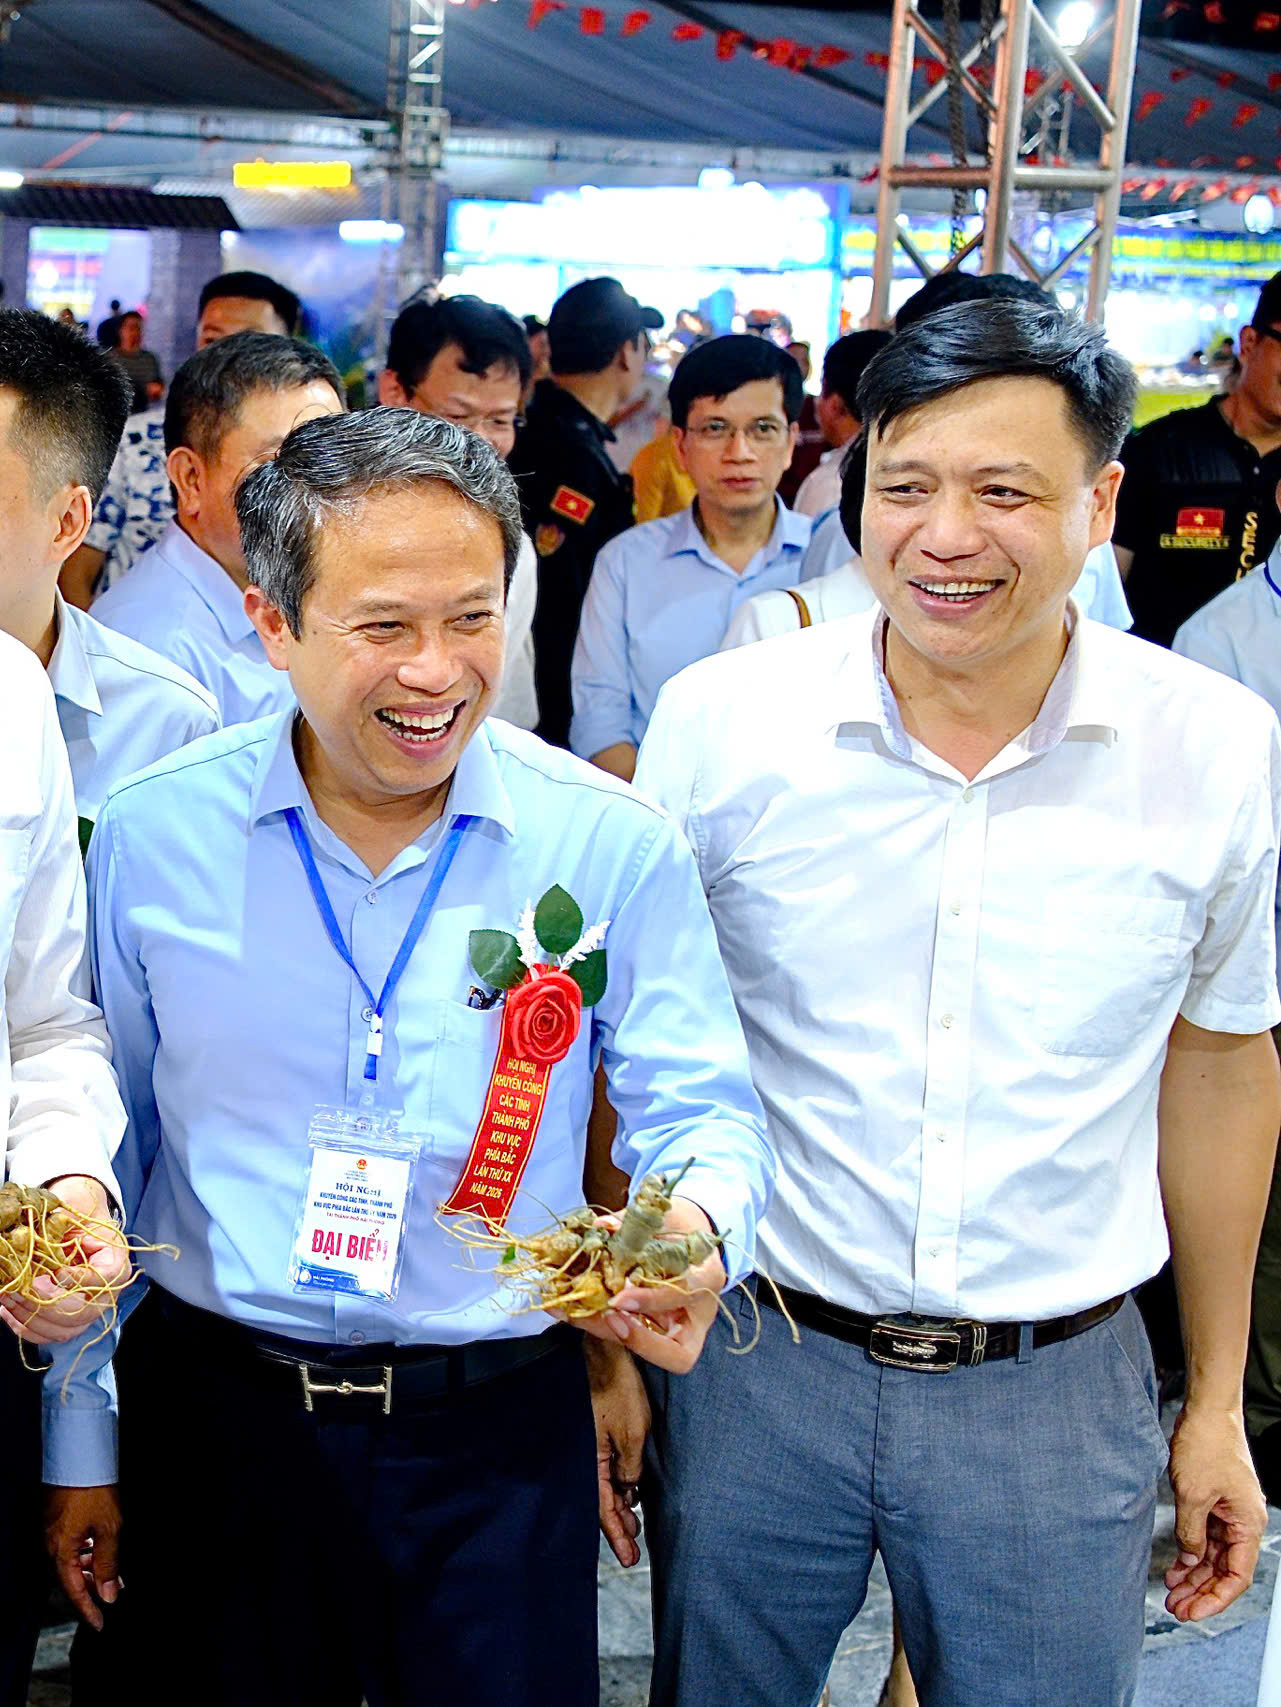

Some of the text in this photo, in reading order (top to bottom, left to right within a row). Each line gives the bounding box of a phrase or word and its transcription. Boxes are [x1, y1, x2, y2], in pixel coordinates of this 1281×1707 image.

[490, 1130, 507, 1145] KHU
[335, 1181, 353, 1192] HỘI
[311, 1229, 342, 1260] ĐẠI
